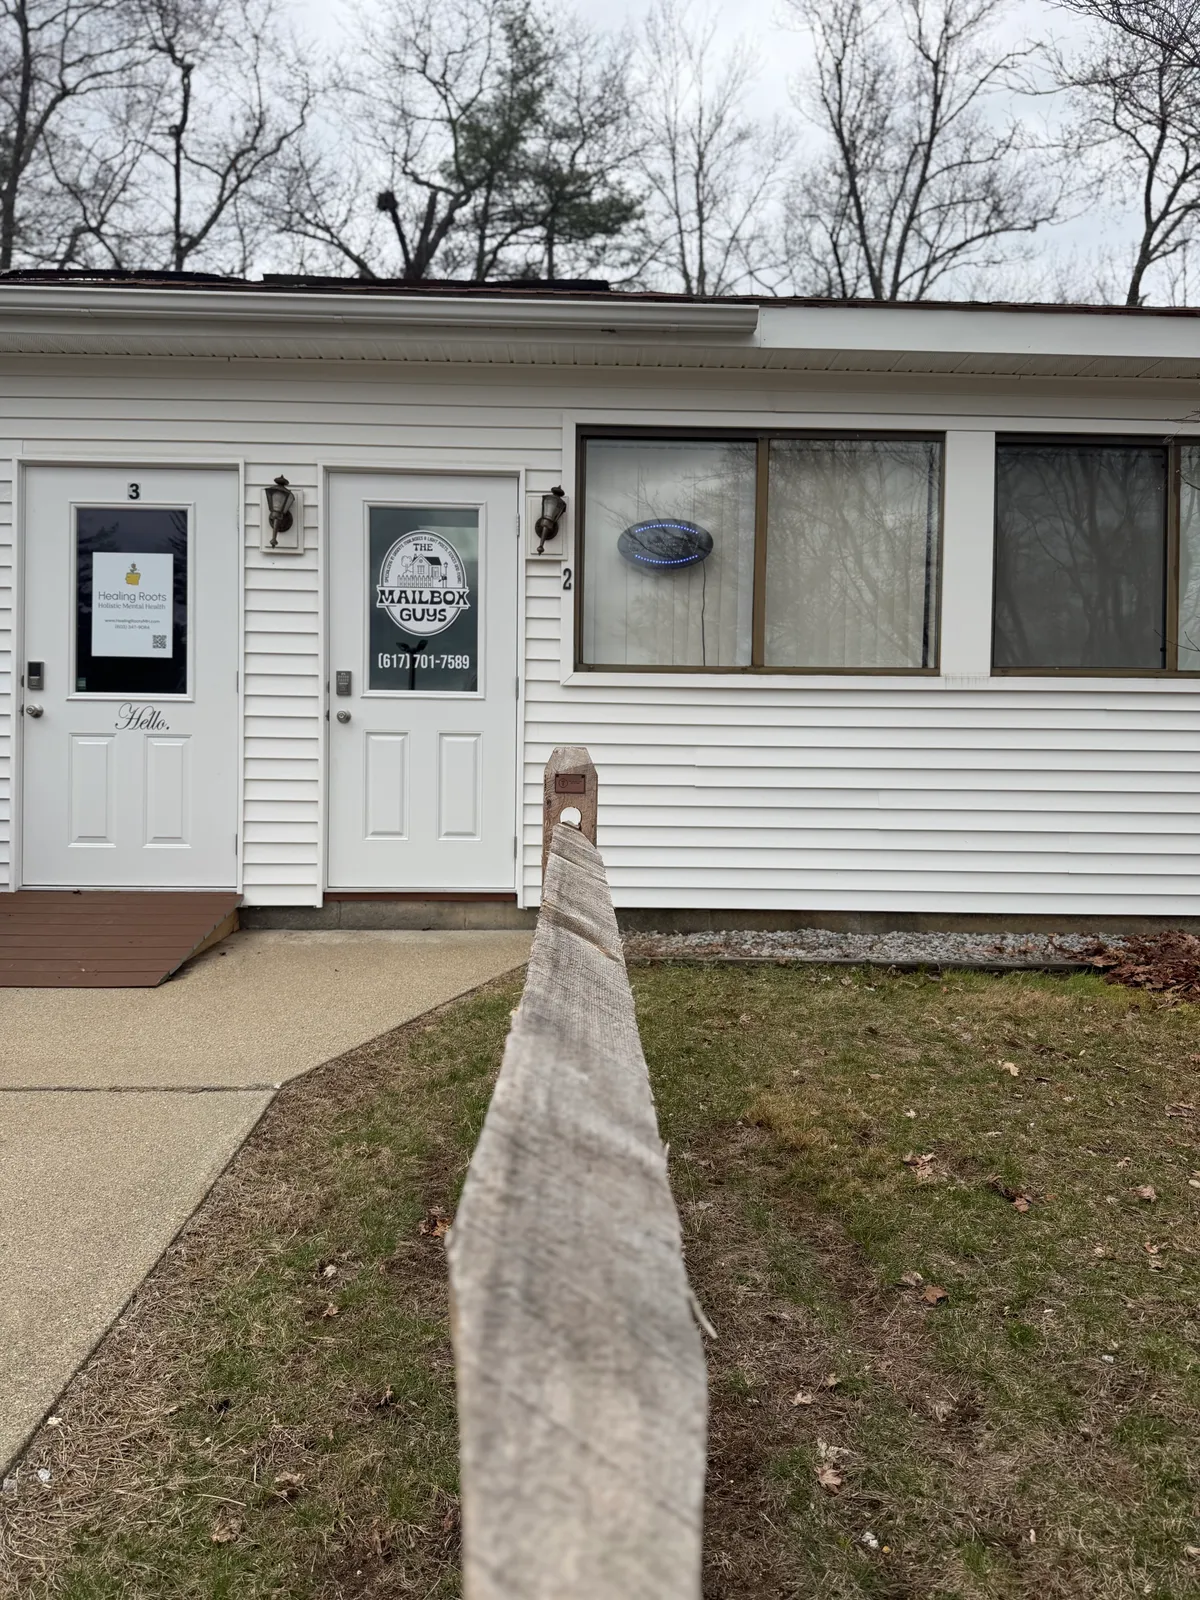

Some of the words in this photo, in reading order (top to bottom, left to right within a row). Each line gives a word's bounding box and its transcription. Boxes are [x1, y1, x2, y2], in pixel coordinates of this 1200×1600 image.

[128, 483, 140, 500] 3
[413, 543, 433, 551] THE
[563, 567, 572, 590] 2
[98, 591, 136, 603] Healing
[139, 592, 167, 602] Roots
[379, 589, 468, 605] MAILBOX
[400, 608, 447, 622] GUYS
[378, 653, 410, 669] (617)
[413, 654, 470, 669] 701-7589
[115, 702, 170, 730] Hello.
